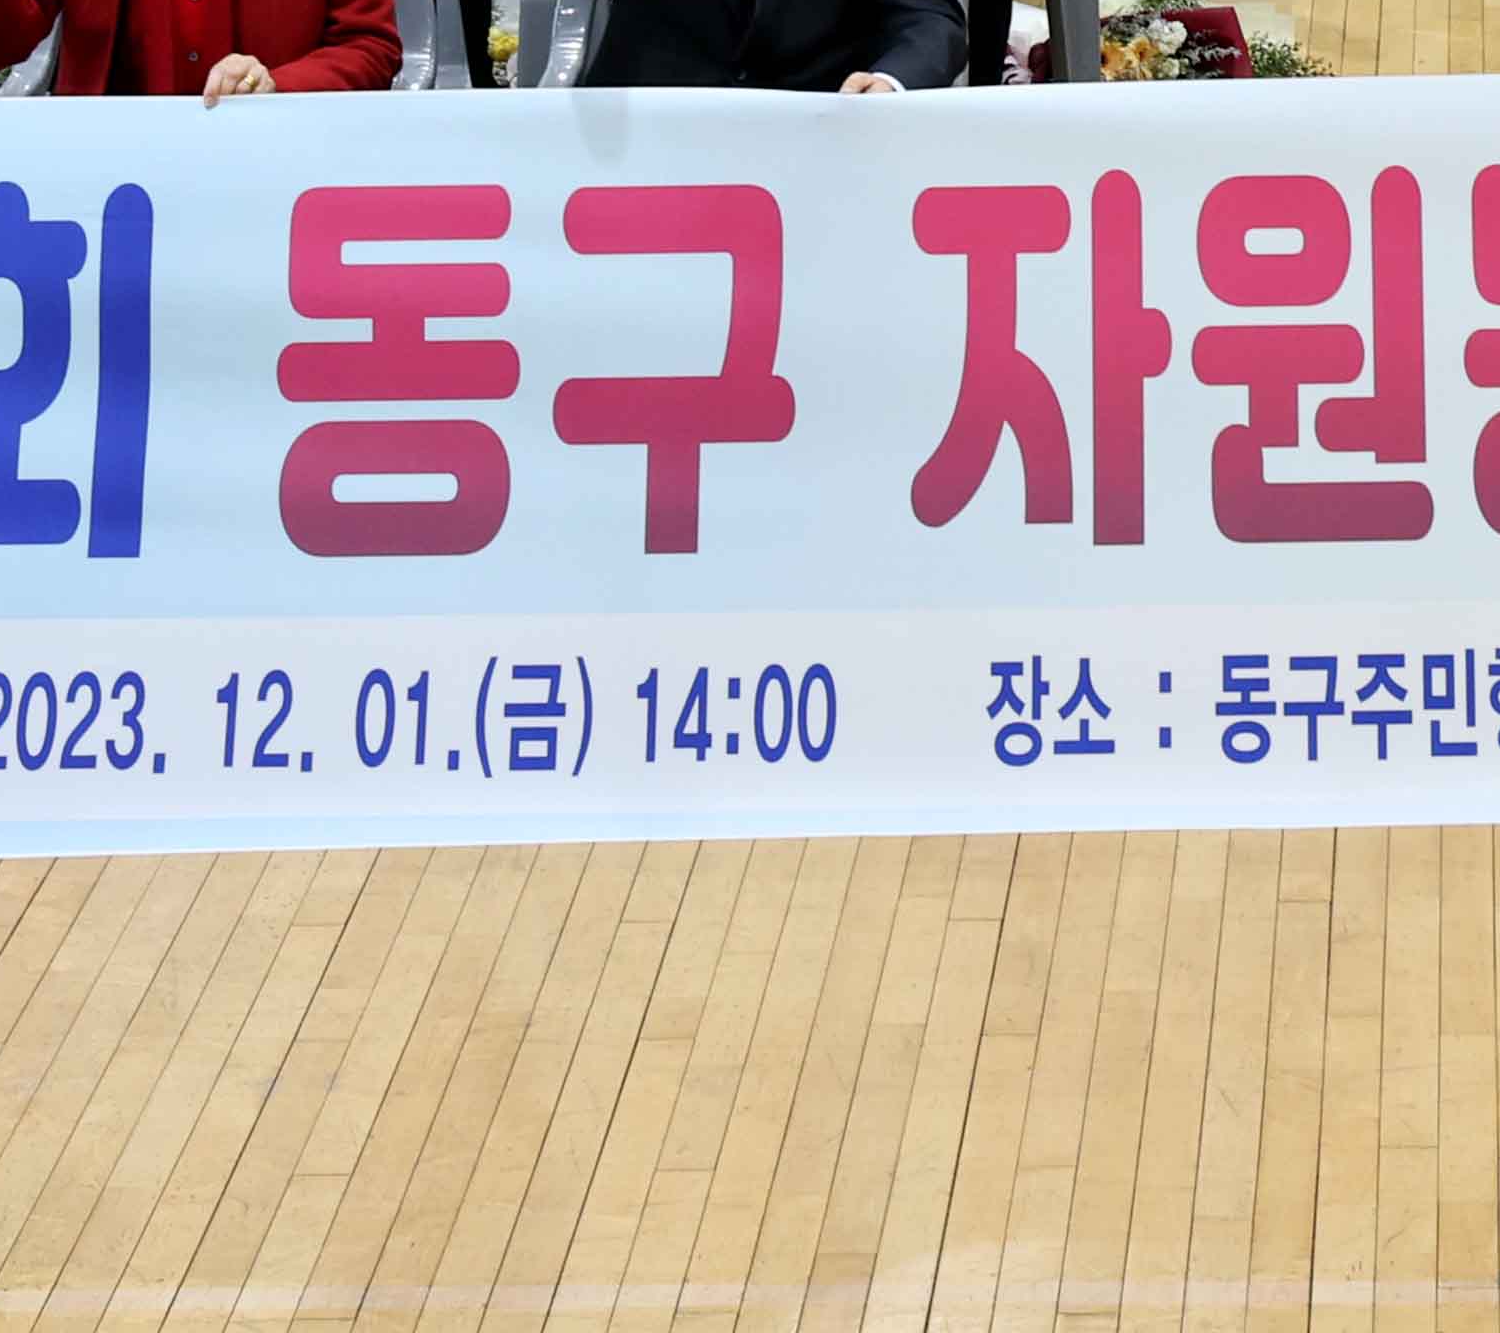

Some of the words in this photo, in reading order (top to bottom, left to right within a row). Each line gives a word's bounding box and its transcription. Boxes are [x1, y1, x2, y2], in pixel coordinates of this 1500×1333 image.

[278, 185, 796, 551] 동구
[216, 669, 313, 773] 12.
[355, 656, 593, 779] 01.(금)
[636, 663, 837, 763] 14:00
[986, 655, 1116, 767] 장소
